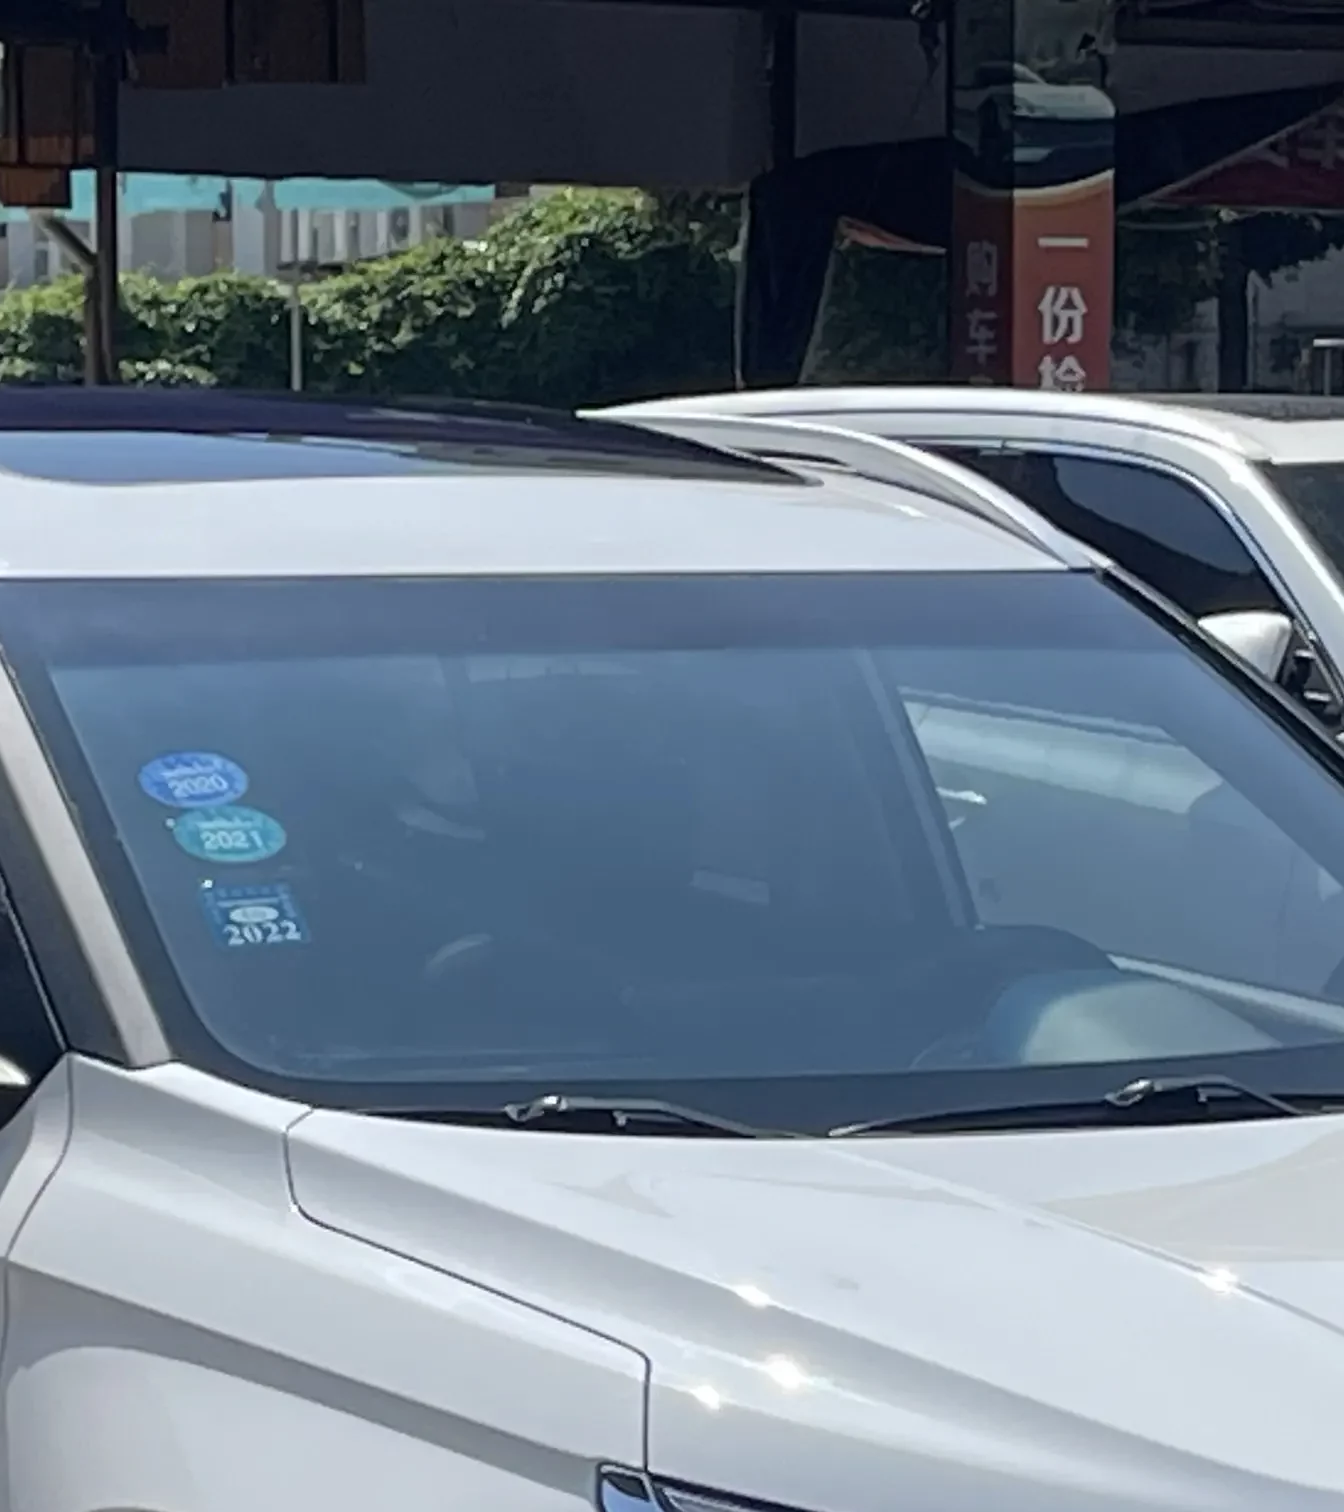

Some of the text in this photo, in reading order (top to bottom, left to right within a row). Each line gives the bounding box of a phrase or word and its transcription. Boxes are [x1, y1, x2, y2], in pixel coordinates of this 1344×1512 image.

[965, 240, 998, 384] 购车
[168, 773, 229, 798] 2020
[200, 830, 264, 850] 2021
[222, 921, 301, 946] 2022
